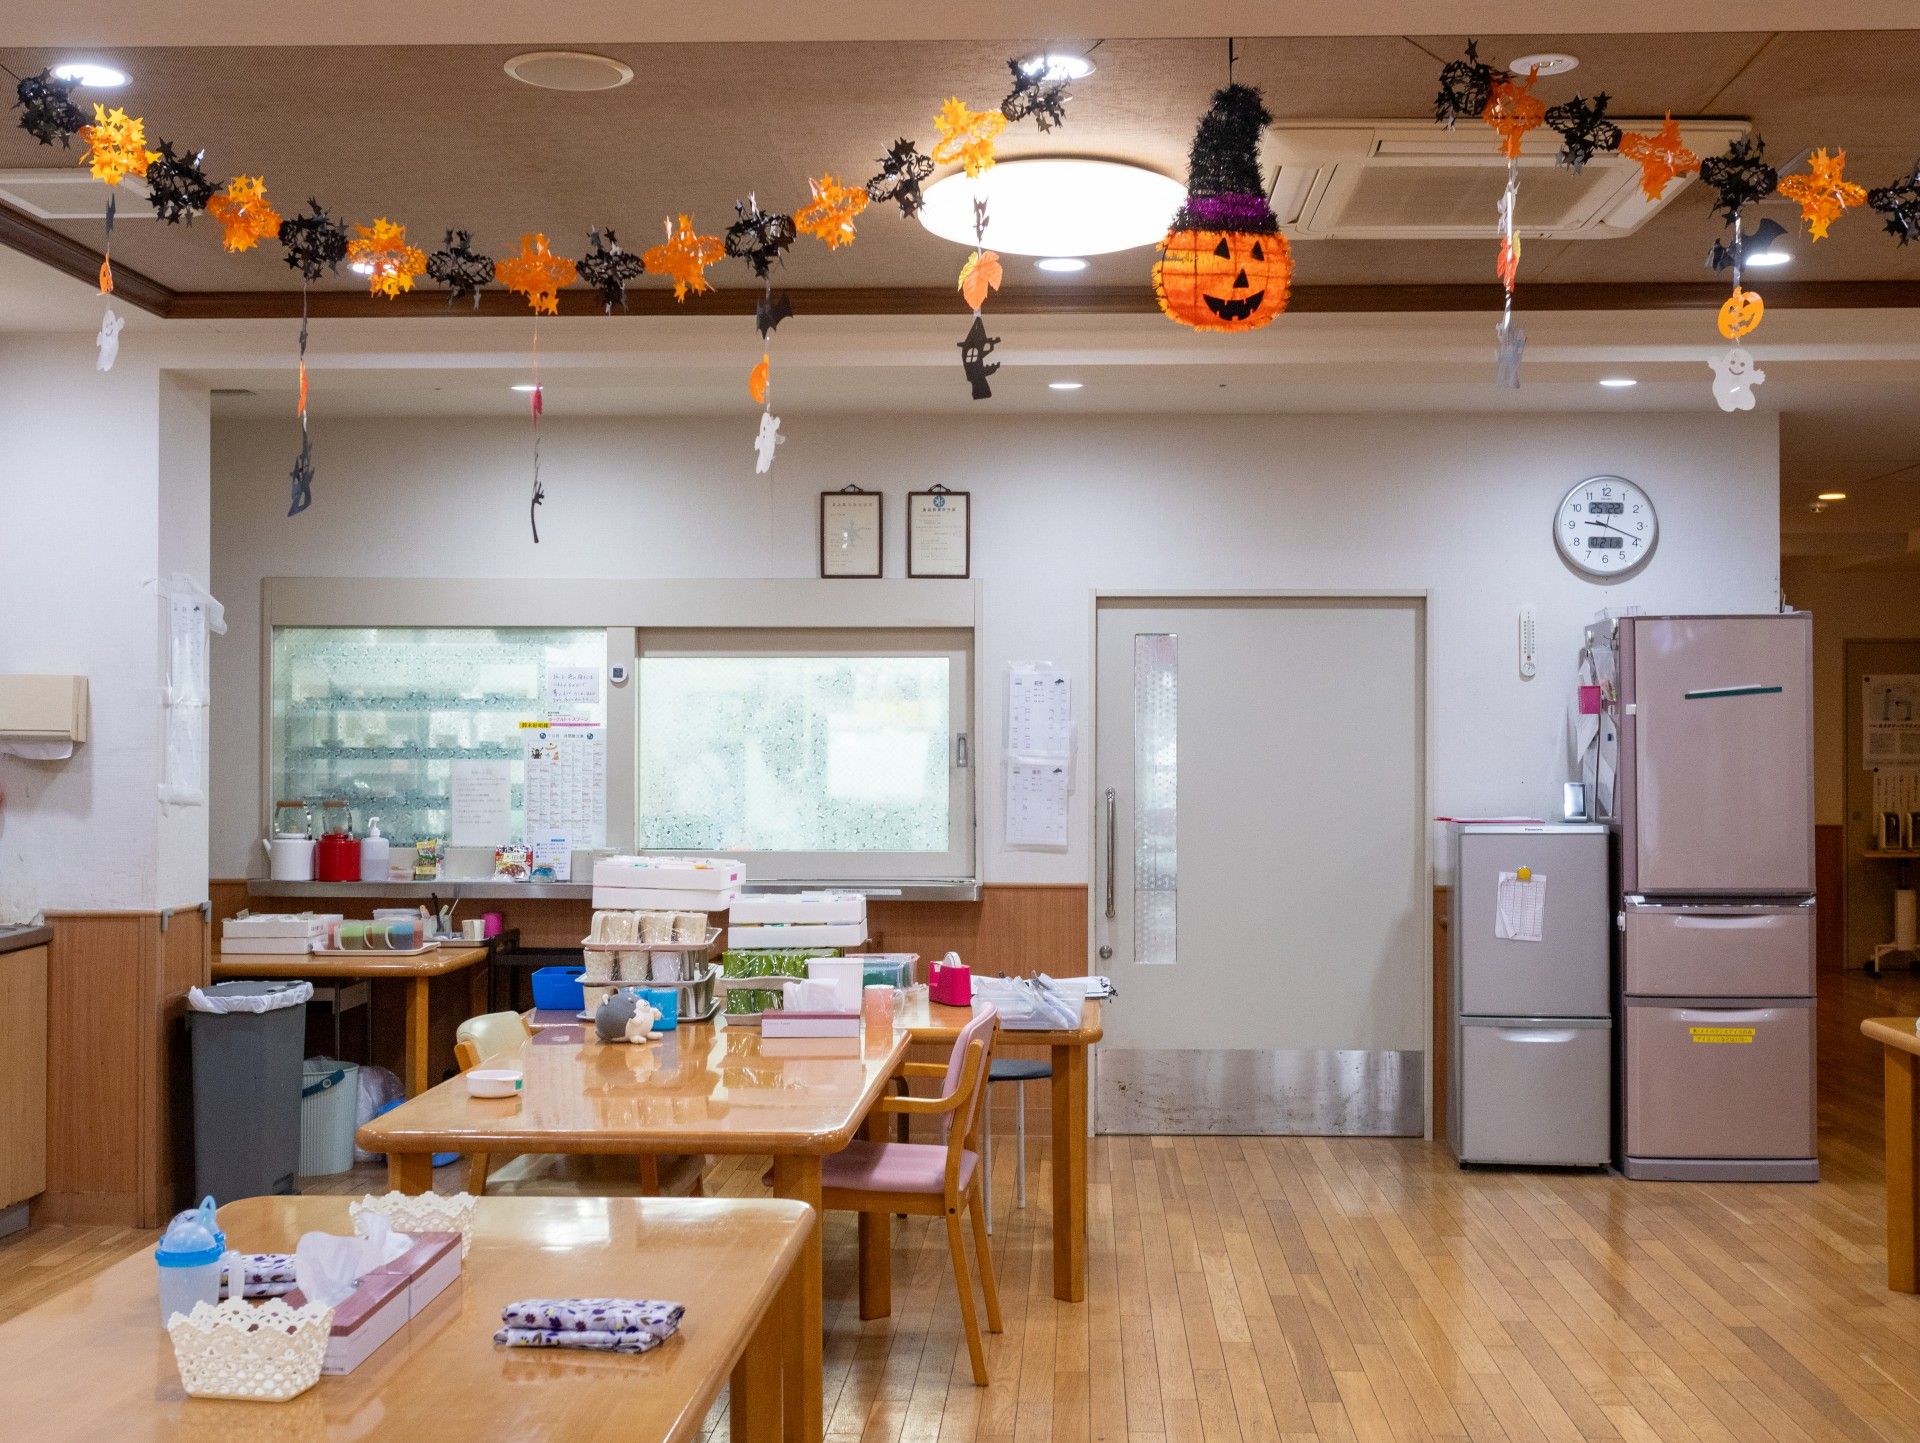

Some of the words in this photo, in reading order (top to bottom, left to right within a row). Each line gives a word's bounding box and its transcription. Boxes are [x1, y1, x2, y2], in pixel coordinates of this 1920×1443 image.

[1602, 488, 1612, 496] 12
[1573, 504, 1582, 512] 10
[1633, 505, 1639, 513] 2
[1568, 521, 1575, 529] 9
[1637, 522, 1643, 530] 3
[1573, 537, 1580, 546] 8
[1632, 539, 1638, 547] 4
[1586, 551, 1591, 559] 7
[1602, 555, 1608, 563] 6
[1619, 551, 1625, 560] 5
